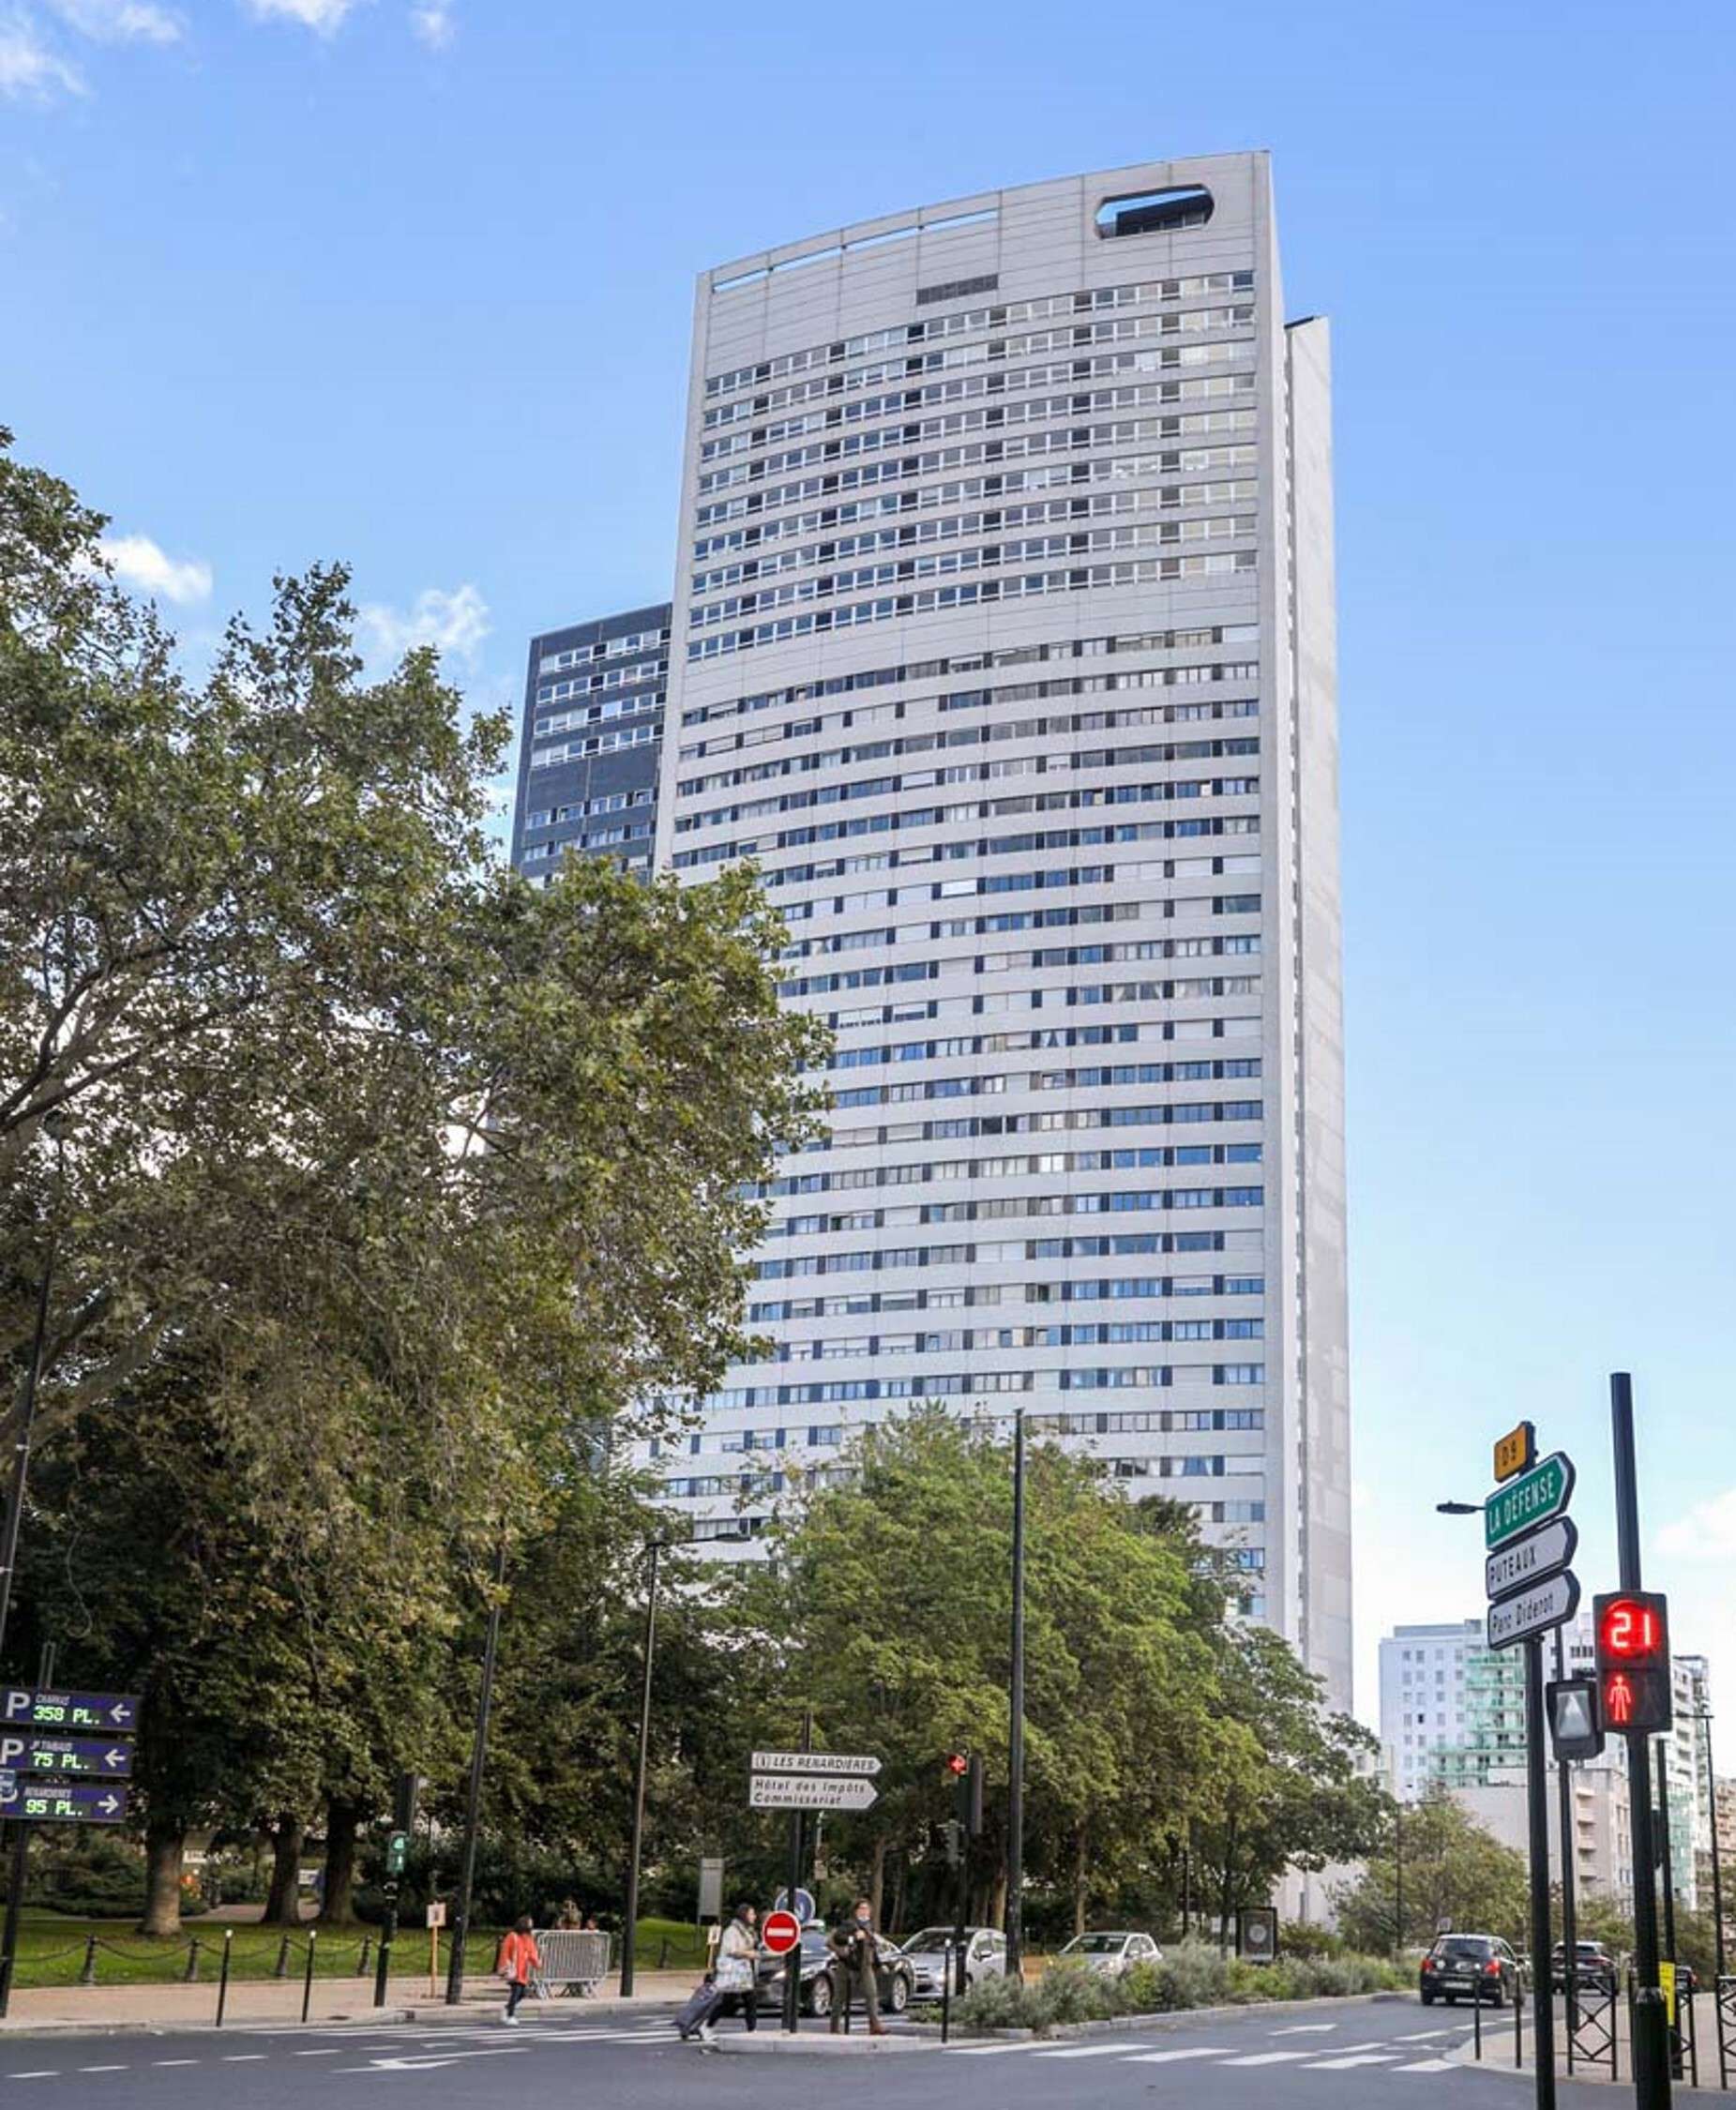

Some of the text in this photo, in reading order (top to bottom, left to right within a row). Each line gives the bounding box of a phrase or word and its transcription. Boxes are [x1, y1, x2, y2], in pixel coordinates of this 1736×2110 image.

[1488, 1471, 1554, 1534] LA DÉFENSE
[1489, 1546, 1536, 1585] PUTEAUX
[1610, 1611, 1652, 1649] 21
[6, 1692, 30, 1718] P
[33, 1705, 100, 1725] 358 PL.
[0, 1738, 24, 1765] P
[33, 1751, 89, 1770] 75 PL.
[774, 1756, 793, 1767] LES
[755, 1780, 789, 1790] Hôtel
[796, 1781, 816, 1790] des
[55, 1800, 83, 1816] PL.
[754, 1792, 842, 1804] Commissariat
